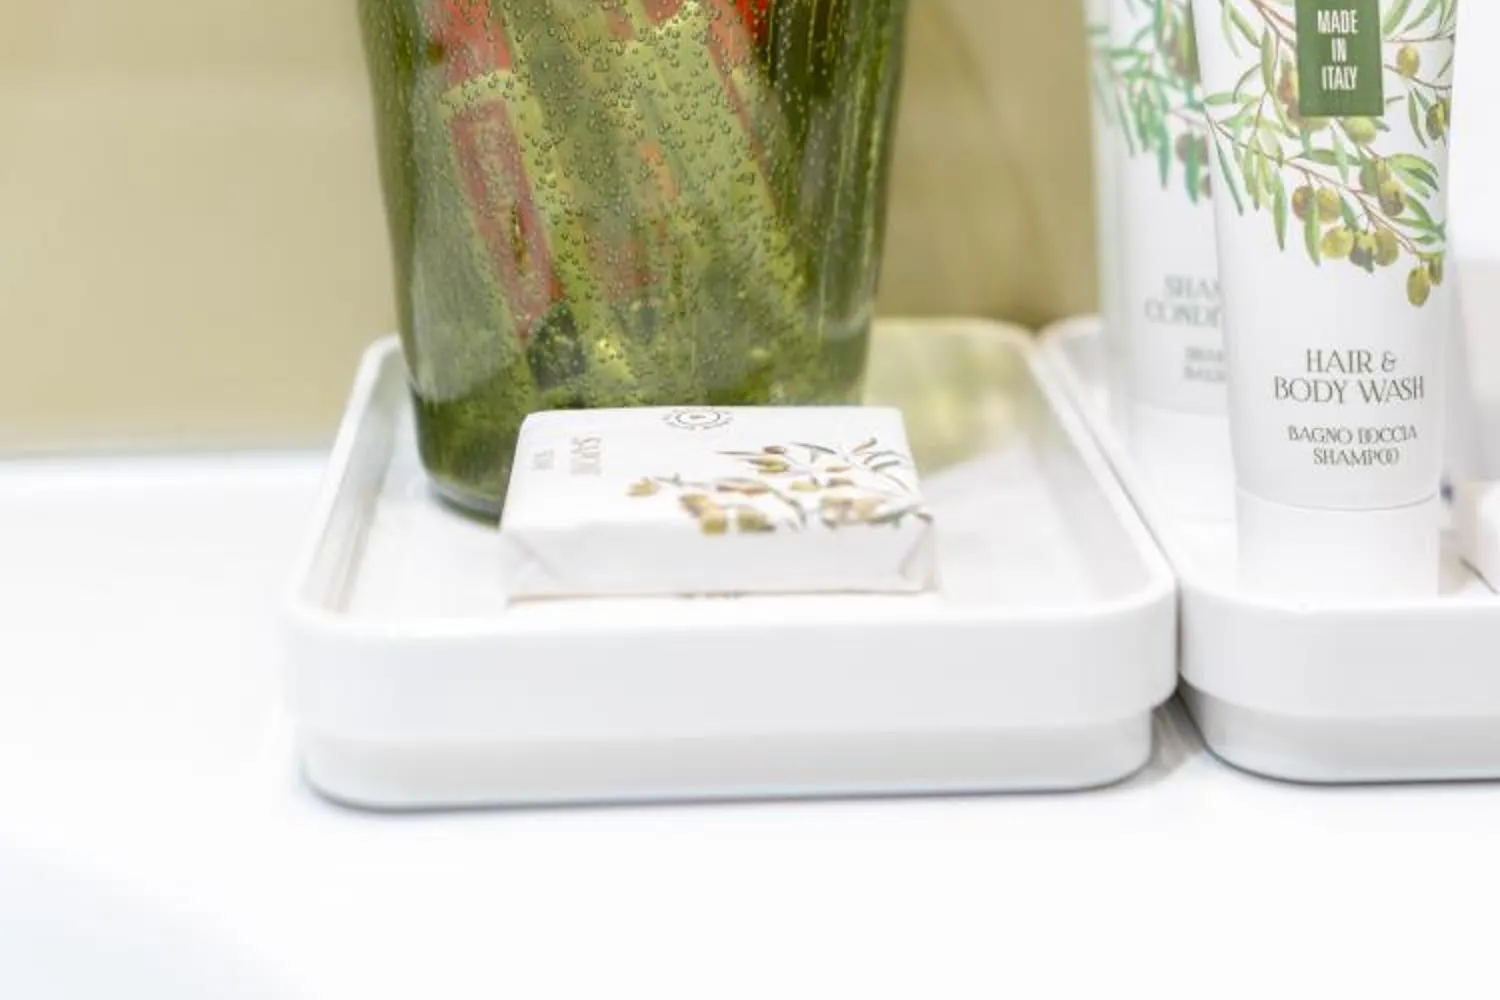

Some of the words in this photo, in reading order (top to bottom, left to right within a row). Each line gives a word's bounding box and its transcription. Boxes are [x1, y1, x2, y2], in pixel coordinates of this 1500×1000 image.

[1316, 9, 1360, 34] MADE
[1331, 38, 1348, 62] IN
[1321, 66, 1360, 91] ITALY
[1305, 348, 1374, 374] HAIR
[1381, 350, 1397, 373] &
[1273, 376, 1350, 404] BODY
[1358, 375, 1425, 403] WASH
[1287, 424, 1353, 445] BAGNO
[1357, 424, 1418, 445] DOCCIA
[1312, 447, 1400, 467] SHAMPOO
